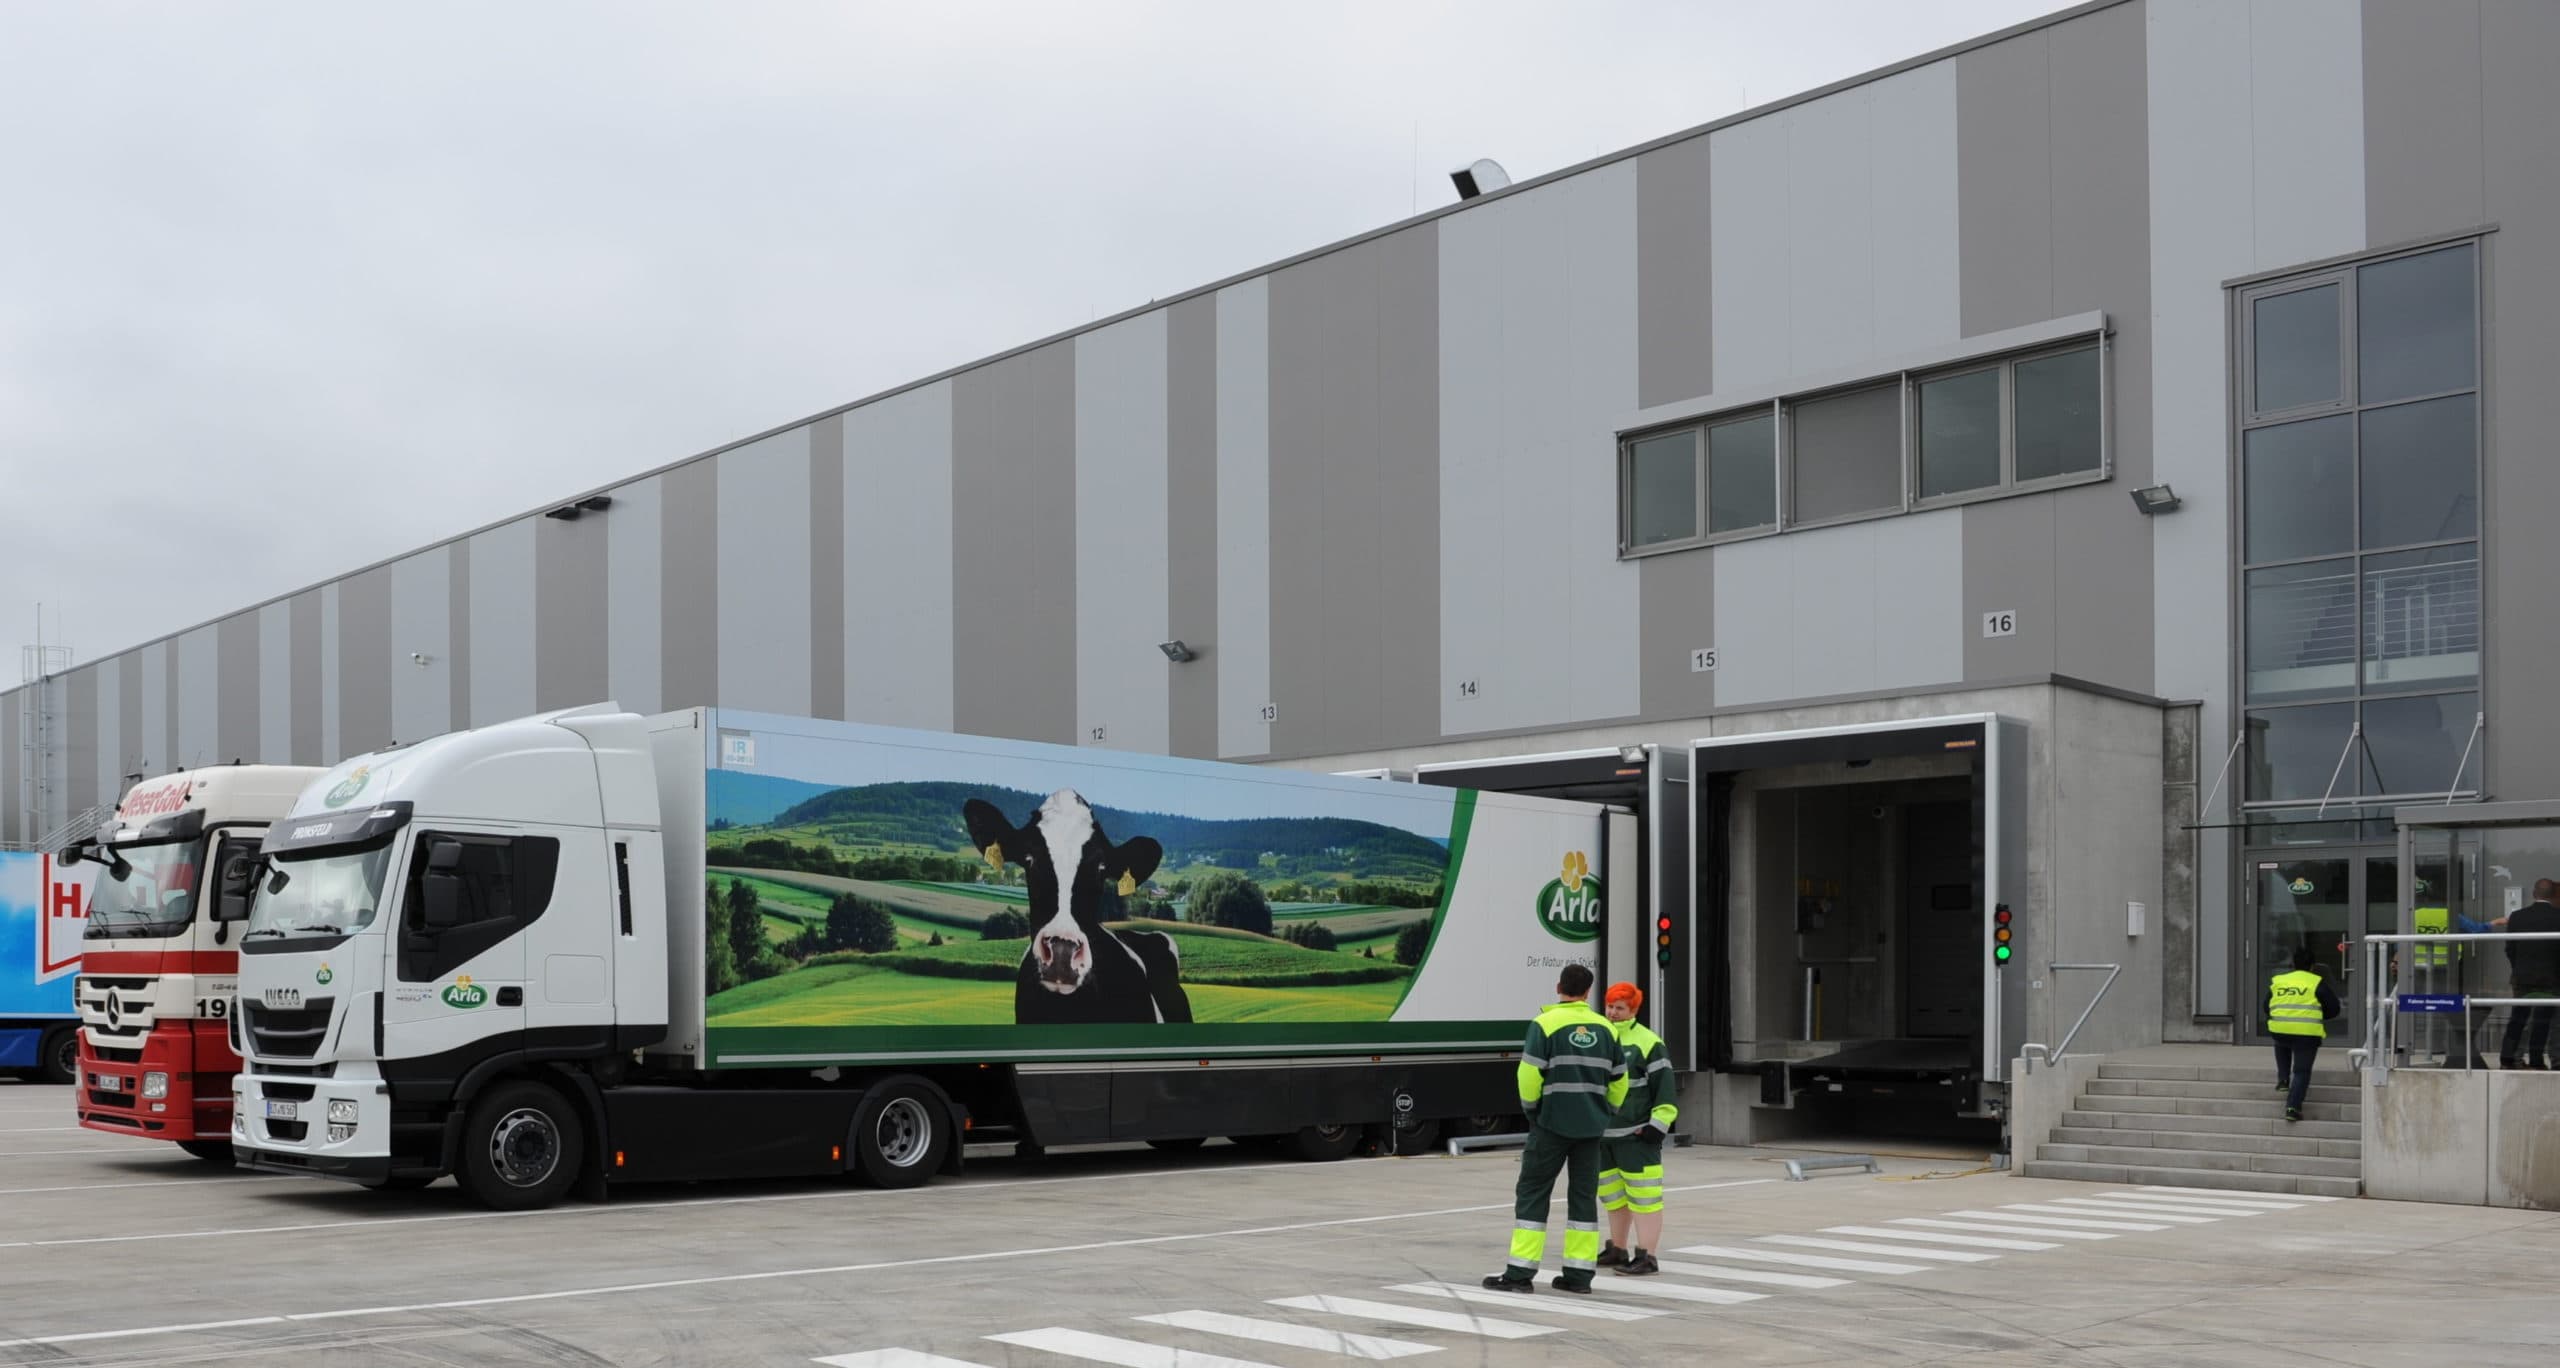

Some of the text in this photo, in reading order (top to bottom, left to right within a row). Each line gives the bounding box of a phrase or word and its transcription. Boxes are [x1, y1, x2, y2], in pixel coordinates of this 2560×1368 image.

[1989, 614, 2012, 633] 16
[1696, 651, 1715, 668] 15
[1460, 681, 1476, 696] 14
[1260, 706, 1275, 720] 13
[1092, 727, 1104, 741] 12
[1548, 886, 1601, 923] Arla
[1527, 955, 1540, 968] Der
[1542, 955, 1562, 968] Natur
[265, 989, 300, 1006] IVECO
[447, 987, 481, 1003] Arla
[2277, 986, 2308, 997] DSV
[196, 999, 227, 1018] 19
[1574, 1034, 1592, 1044] Arla
[1398, 1099, 1411, 1107] STOP
